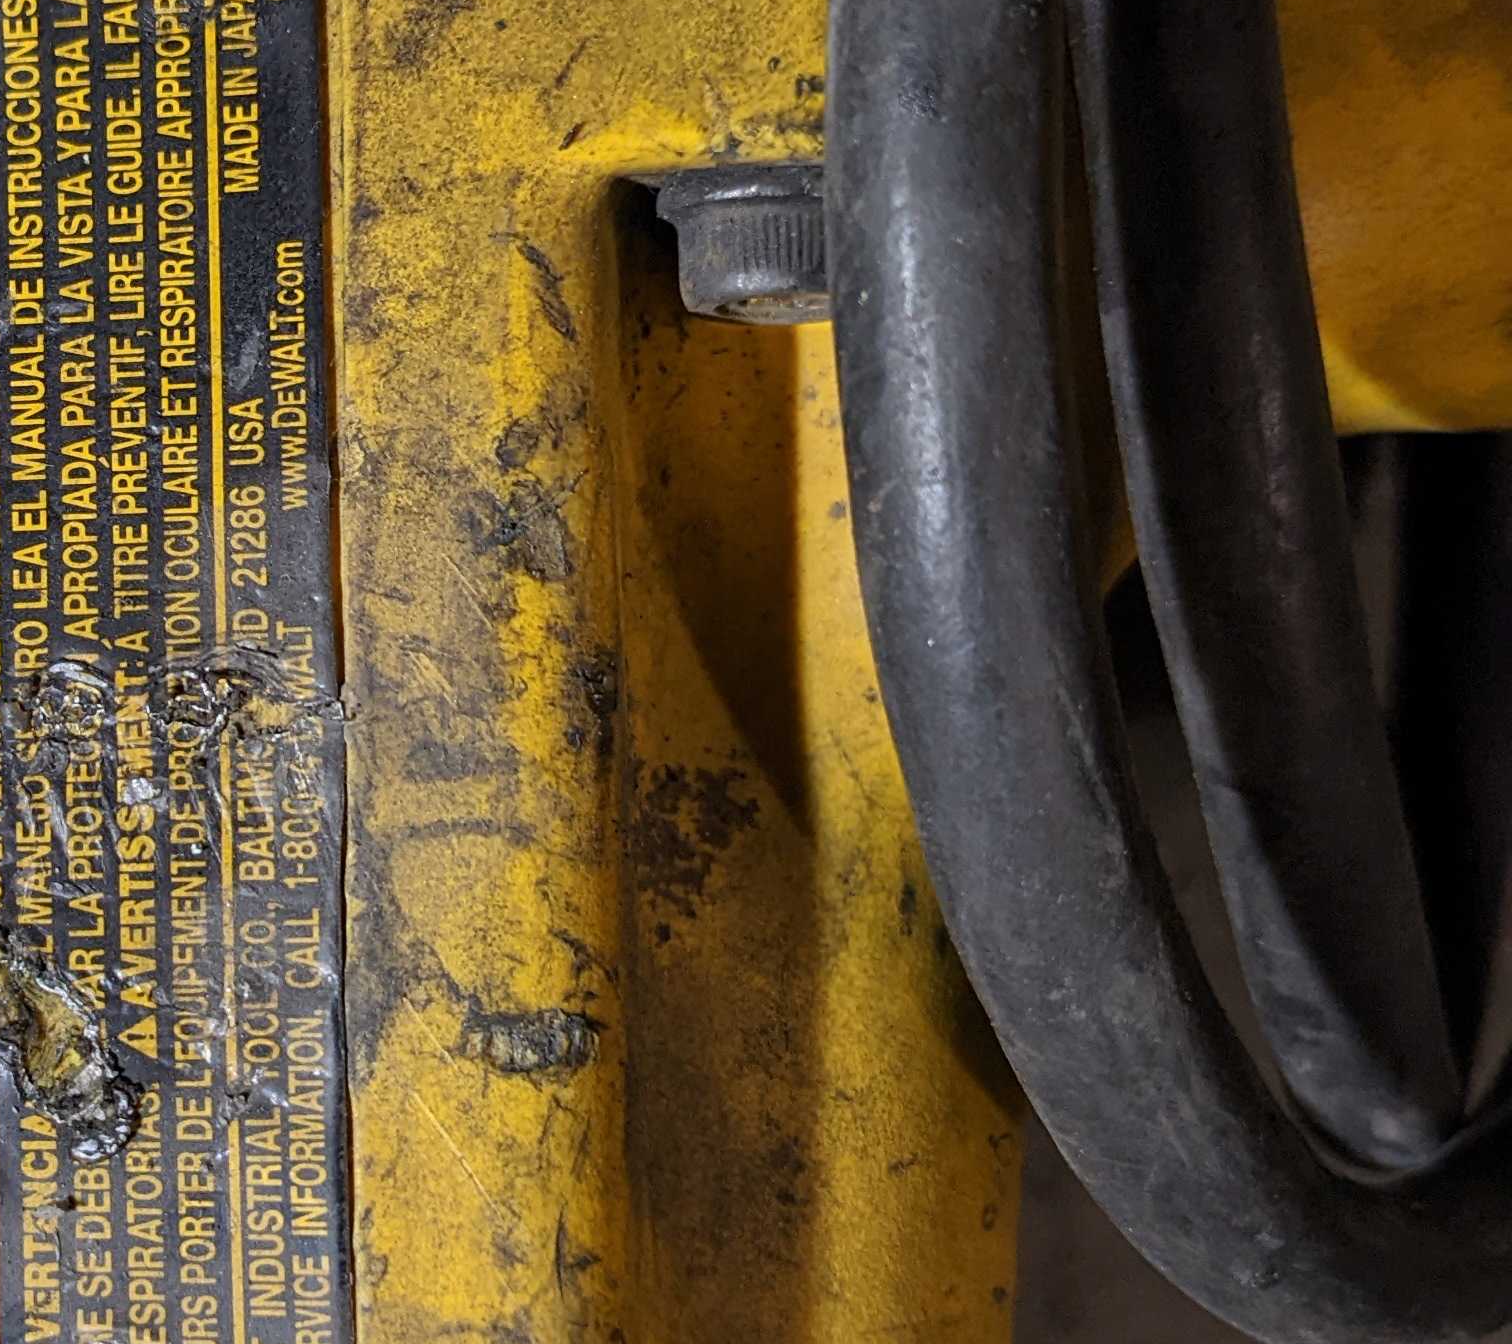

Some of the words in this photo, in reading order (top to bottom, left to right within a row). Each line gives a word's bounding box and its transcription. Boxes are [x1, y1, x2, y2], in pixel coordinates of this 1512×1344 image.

[53, 38, 92, 131] PARA
[103, 51, 140, 80] IL
[221, 67, 259, 96] IN
[55, 139, 92, 160] Y
[104, 87, 143, 196] GUIDE.
[223, 103, 261, 194] MADE
[55, 171, 94, 268] VISTA
[107, 204, 144, 244] LE
[155, 148, 198, 368] RESPIRATOIRE
[6, 278, 45, 325] DE
[56, 278, 95, 325] LA
[108, 252, 146, 321] LIRE
[8, 333, 47, 482] MANUAL
[57, 334, 97, 427] PARA
[99, 330, 153, 516] PRÉVENTIF,
[160, 377, 198, 417] ET
[227, 396, 266, 467] USA
[11, 489, 49, 532] EL
[60, 437, 99, 641] APROPIADA
[159, 423, 201, 581] OCULAIRE
[228, 484, 269, 588] 21286
[11, 542, 50, 609] LEA
[110, 524, 149, 619] TITRE
[14, 773, 55, 925] MANEJO
[168, 800, 208, 845] DE
[68, 892, 106, 936] LA
[282, 907, 322, 990] CALL
[175, 1095, 214, 1141] DE
[285, 1009, 332, 1236] INFORMATION.
[176, 1152, 220, 1285] PORTER
[243, 1106, 287, 1319] INDUSTRIAL
[74, 1250, 115, 1297] SE
